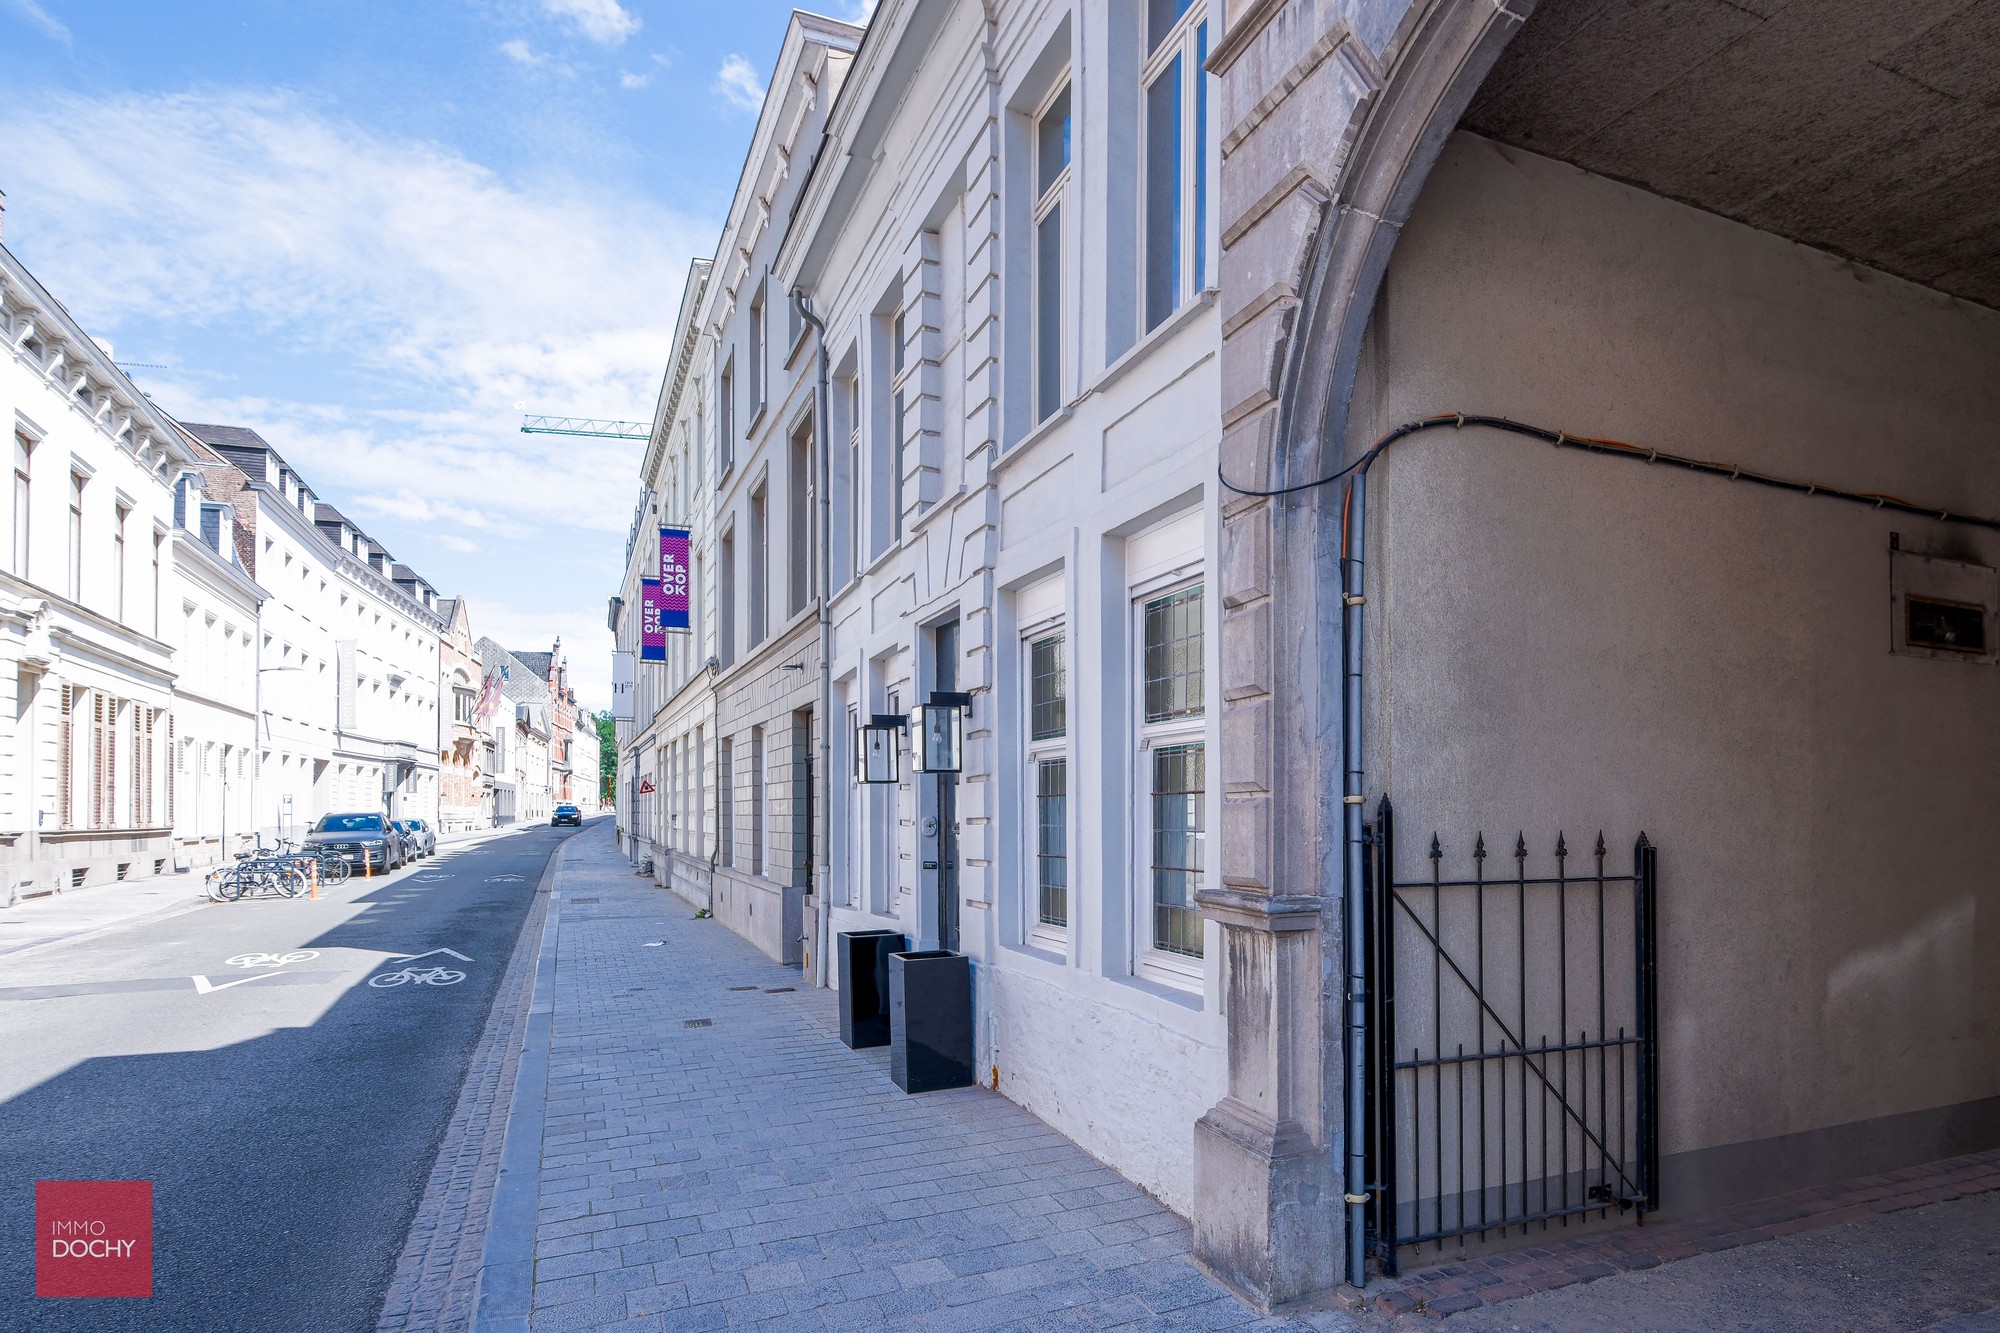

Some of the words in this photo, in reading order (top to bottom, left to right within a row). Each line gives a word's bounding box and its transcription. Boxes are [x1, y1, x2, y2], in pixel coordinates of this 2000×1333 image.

[663, 553, 675, 595] OVER
[675, 564, 687, 596] KOP
[644, 599, 654, 634] OVER
[343, 696, 352, 725] HOTEL
